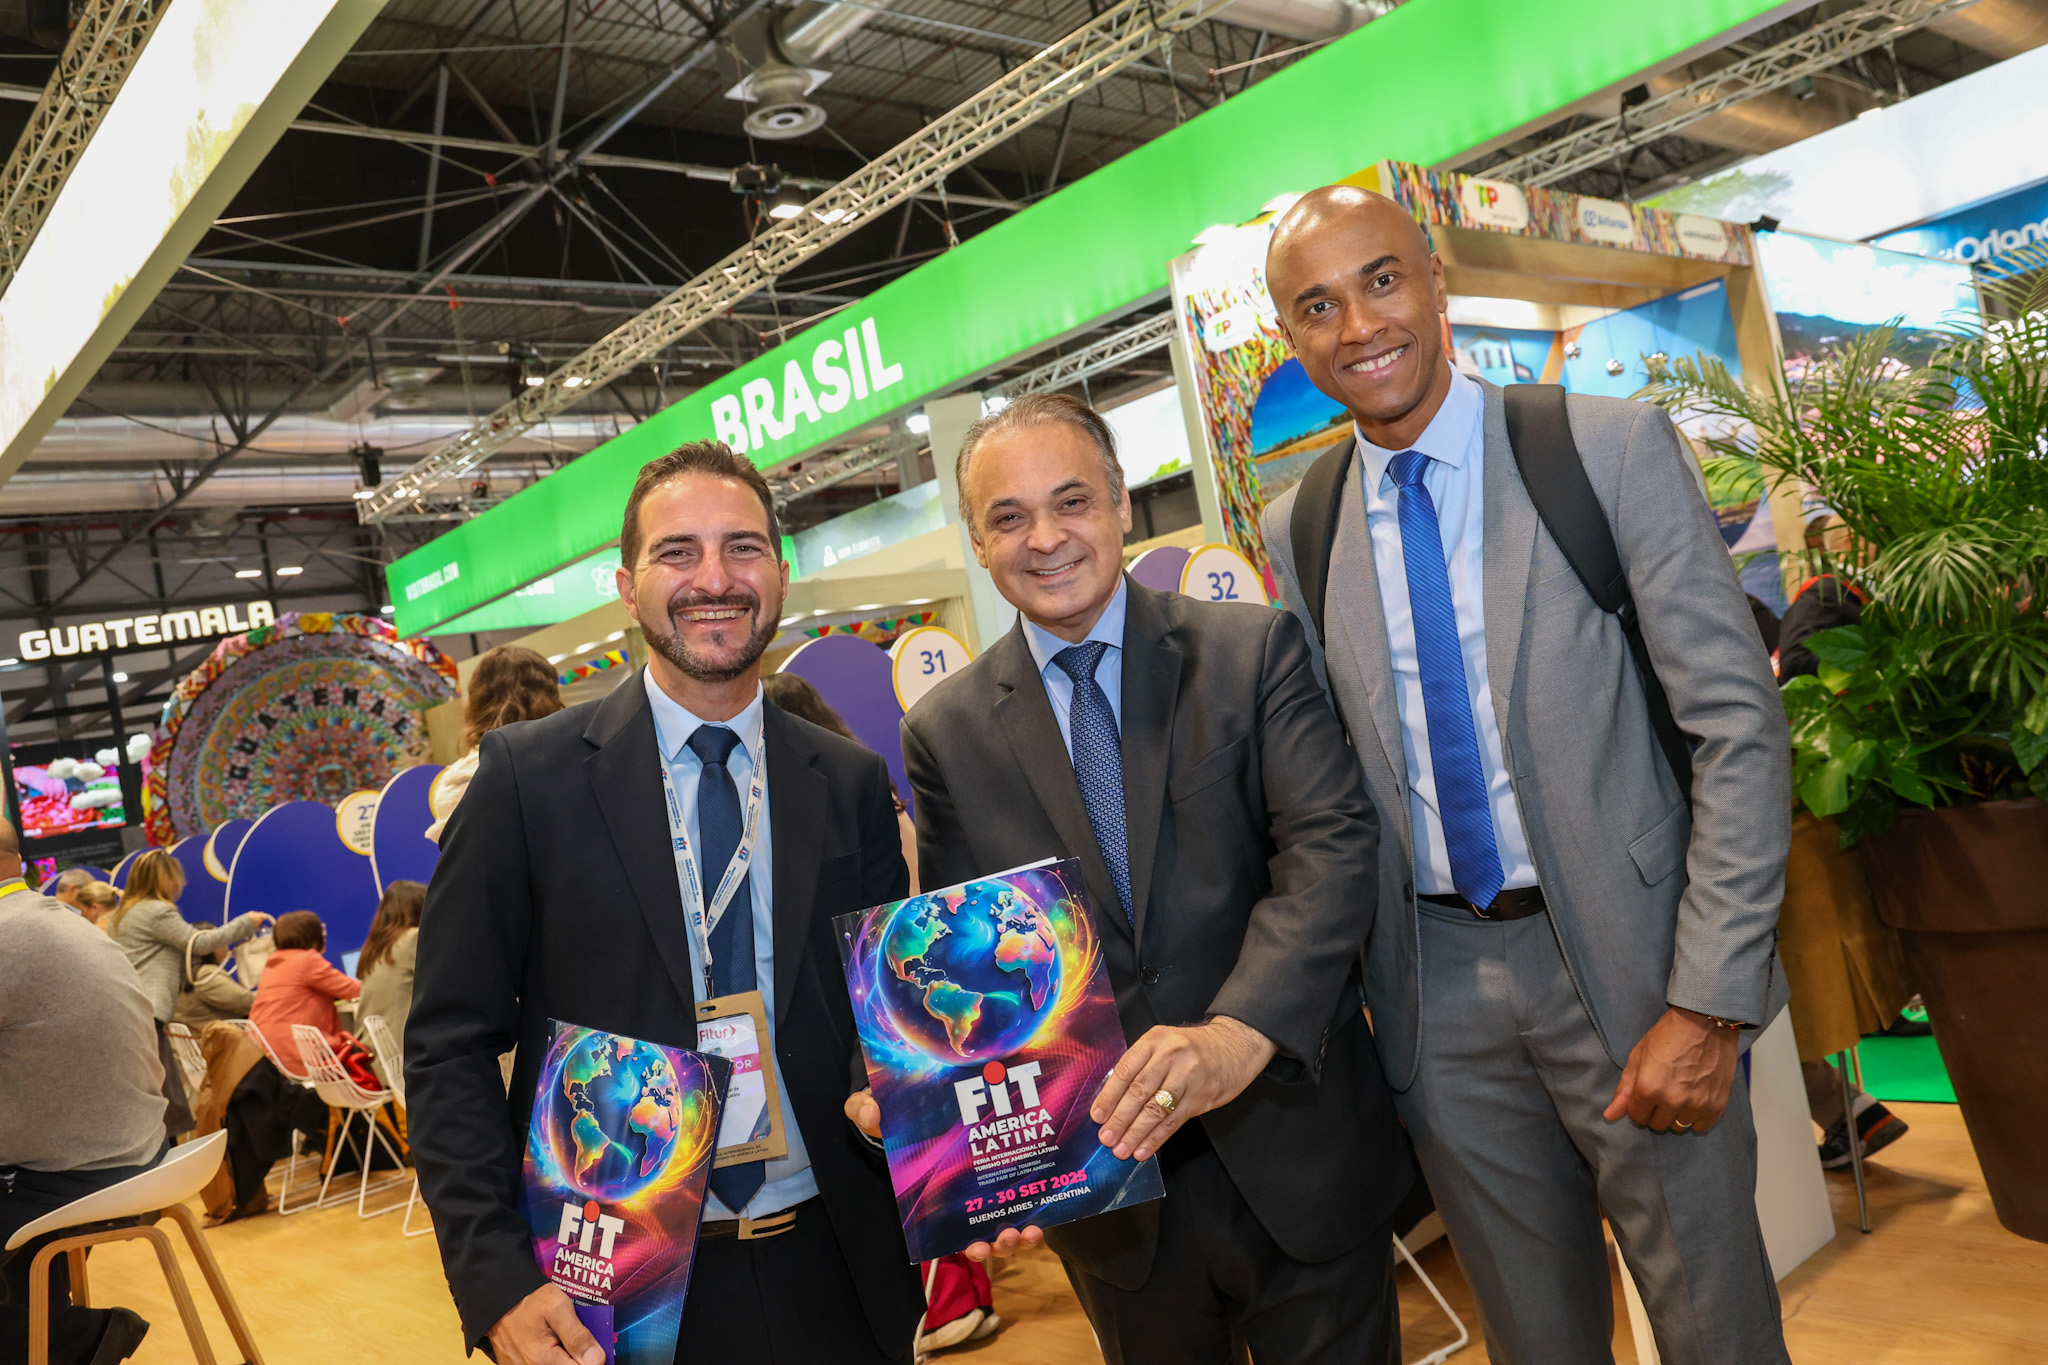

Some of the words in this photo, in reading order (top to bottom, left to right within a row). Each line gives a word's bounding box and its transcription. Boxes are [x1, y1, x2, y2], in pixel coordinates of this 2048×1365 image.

[711, 316, 904, 455] BRASIL
[1207, 570, 1240, 602] 32
[19, 600, 276, 661] GUATEMALA
[919, 648, 947, 676] 31
[699, 1027, 729, 1042] Fitur
[968, 1109, 1052, 1143] AMERICA
[970, 1123, 1056, 1157] LATINA
[973, 1157, 991, 1167] FERIA
[990, 1144, 1038, 1161] INTERNACIONAL
[1038, 1141, 1047, 1149] DE
[974, 1161, 1002, 1173] TURISMO
[1010, 1151, 1038, 1163] AMERICA
[1038, 1145, 1059, 1156] LATINA
[977, 1166, 1018, 1181] INTERNATIONAL
[1018, 1159, 1041, 1170] TOURISM
[978, 1179, 996, 1187] TRADE
[1017, 1168, 1032, 1177] LATIN
[1032, 1161, 1057, 1173] AMERICA
[965, 1197, 984, 1213] 27
[996, 1190, 1016, 1205] 30
[1018, 1179, 1048, 1198] SET
[1051, 1169, 1088, 1190] 2025
[968, 1208, 1006, 1226] BUENOS
[1007, 1201, 1034, 1216] AIRES
[1040, 1186, 1092, 1207] ARGENTINA
[553, 1260, 612, 1291] LATINA
[555, 1247, 615, 1277] AMERICA
[551, 1274, 562, 1284] FERIA
[561, 1279, 595, 1296] INTERNACIONAL
[595, 1289, 603, 1297] DE
[566, 1287, 573, 1295] DE
[573, 1289, 593, 1302] AMERICA
[593, 1295, 610, 1306] LATINA
